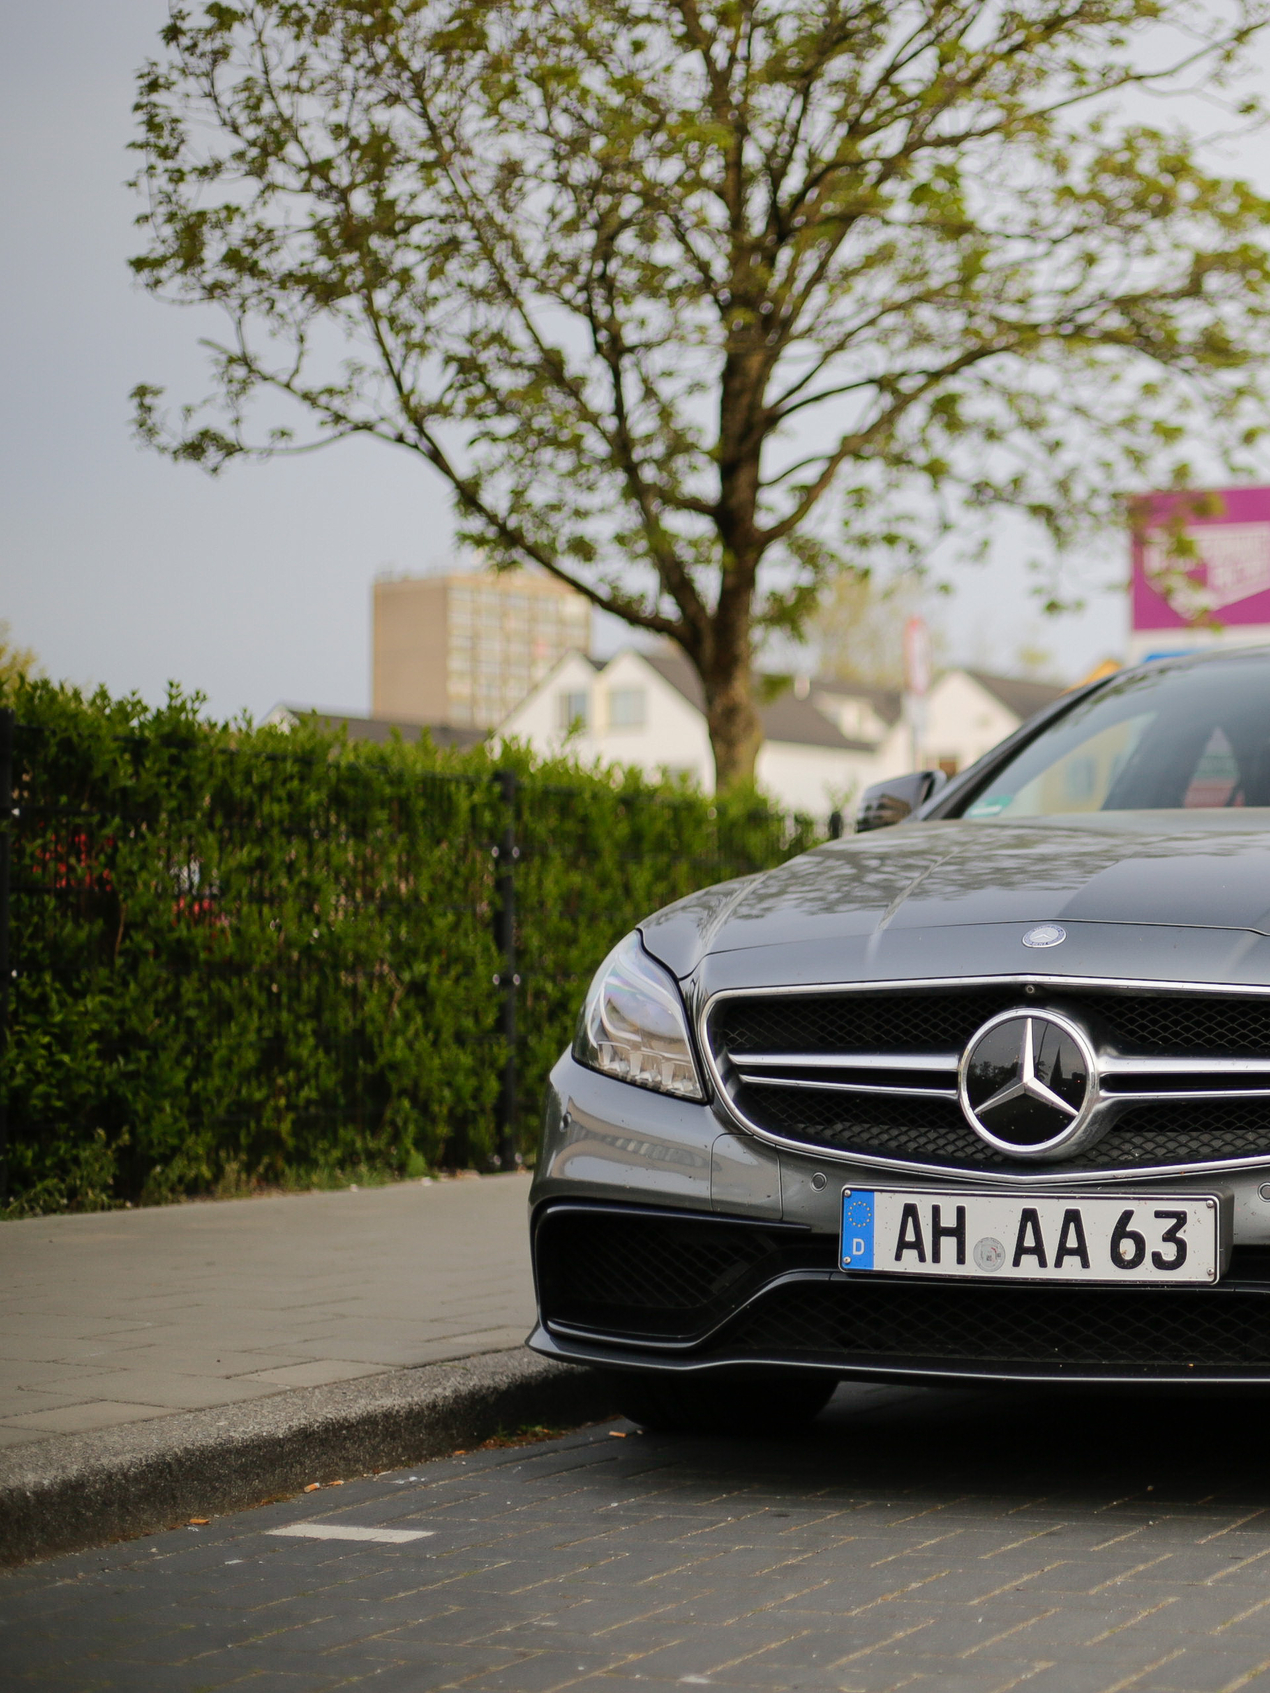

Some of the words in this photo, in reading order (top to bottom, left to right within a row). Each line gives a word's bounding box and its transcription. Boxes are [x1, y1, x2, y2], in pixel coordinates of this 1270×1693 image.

[852, 1238, 865, 1255] D
[894, 1202, 967, 1265] AH
[1012, 1207, 1091, 1269] AA
[1110, 1208, 1188, 1271] 63
